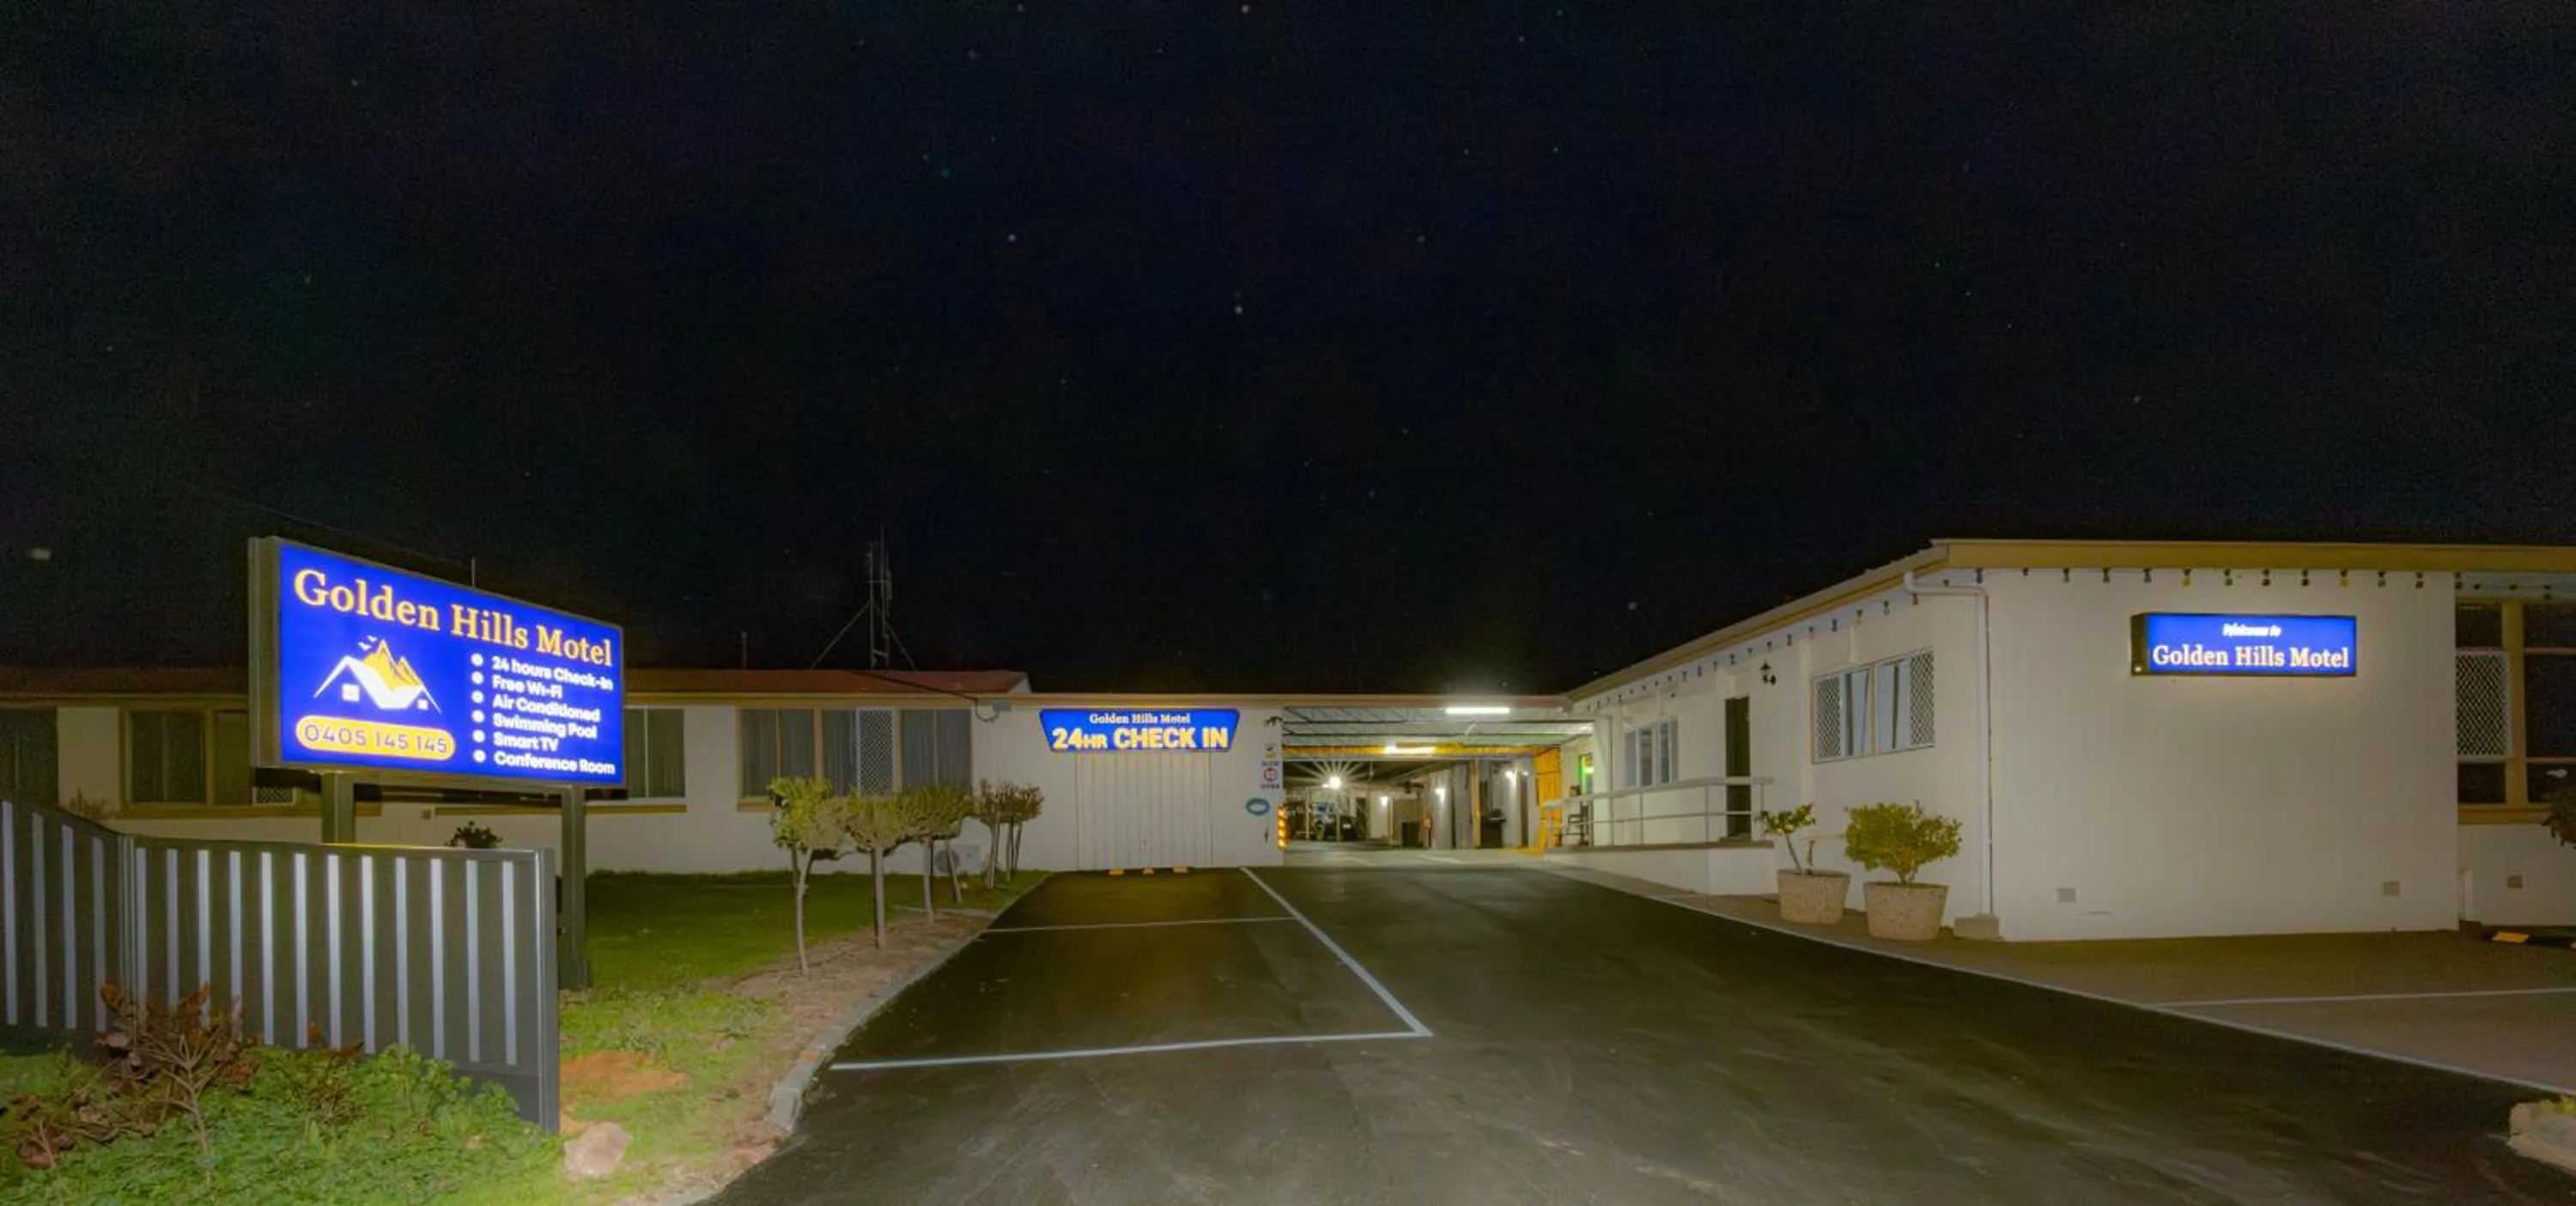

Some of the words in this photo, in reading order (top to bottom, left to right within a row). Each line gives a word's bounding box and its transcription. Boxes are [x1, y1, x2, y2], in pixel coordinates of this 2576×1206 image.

[294, 569, 440, 631] Golden
[450, 604, 529, 649] Hills
[536, 625, 613, 667] Motel
[2153, 644, 2229, 666] Golden
[2234, 645, 2285, 667] Hills
[2289, 647, 2348, 668] Motel
[492, 655, 509, 672] 24
[512, 659, 551, 679] hours
[554, 667, 613, 691] Check-in
[492, 674, 525, 693] Free
[526, 679, 562, 698] Wi-Fi
[492, 694, 514, 710] Air
[516, 697, 601, 722] Conditioned
[1090, 712, 1129, 723] Golden
[1132, 712, 1158, 723] Hills
[1160, 712, 1191, 723] Motel
[492, 712, 567, 738] Swimming
[568, 722, 598, 739] Pool
[304, 724, 367, 746] 0405
[374, 731, 409, 750] 145
[416, 734, 447, 753] 145
[493, 731, 539, 751] Smart
[540, 736, 559, 752] TV
[1052, 728, 1109, 749] 24HR
[1113, 728, 1196, 749] CHECK
[1202, 728, 1228, 749] IN
[494, 750, 577, 771] Conference
[579, 758, 616, 775] Room
